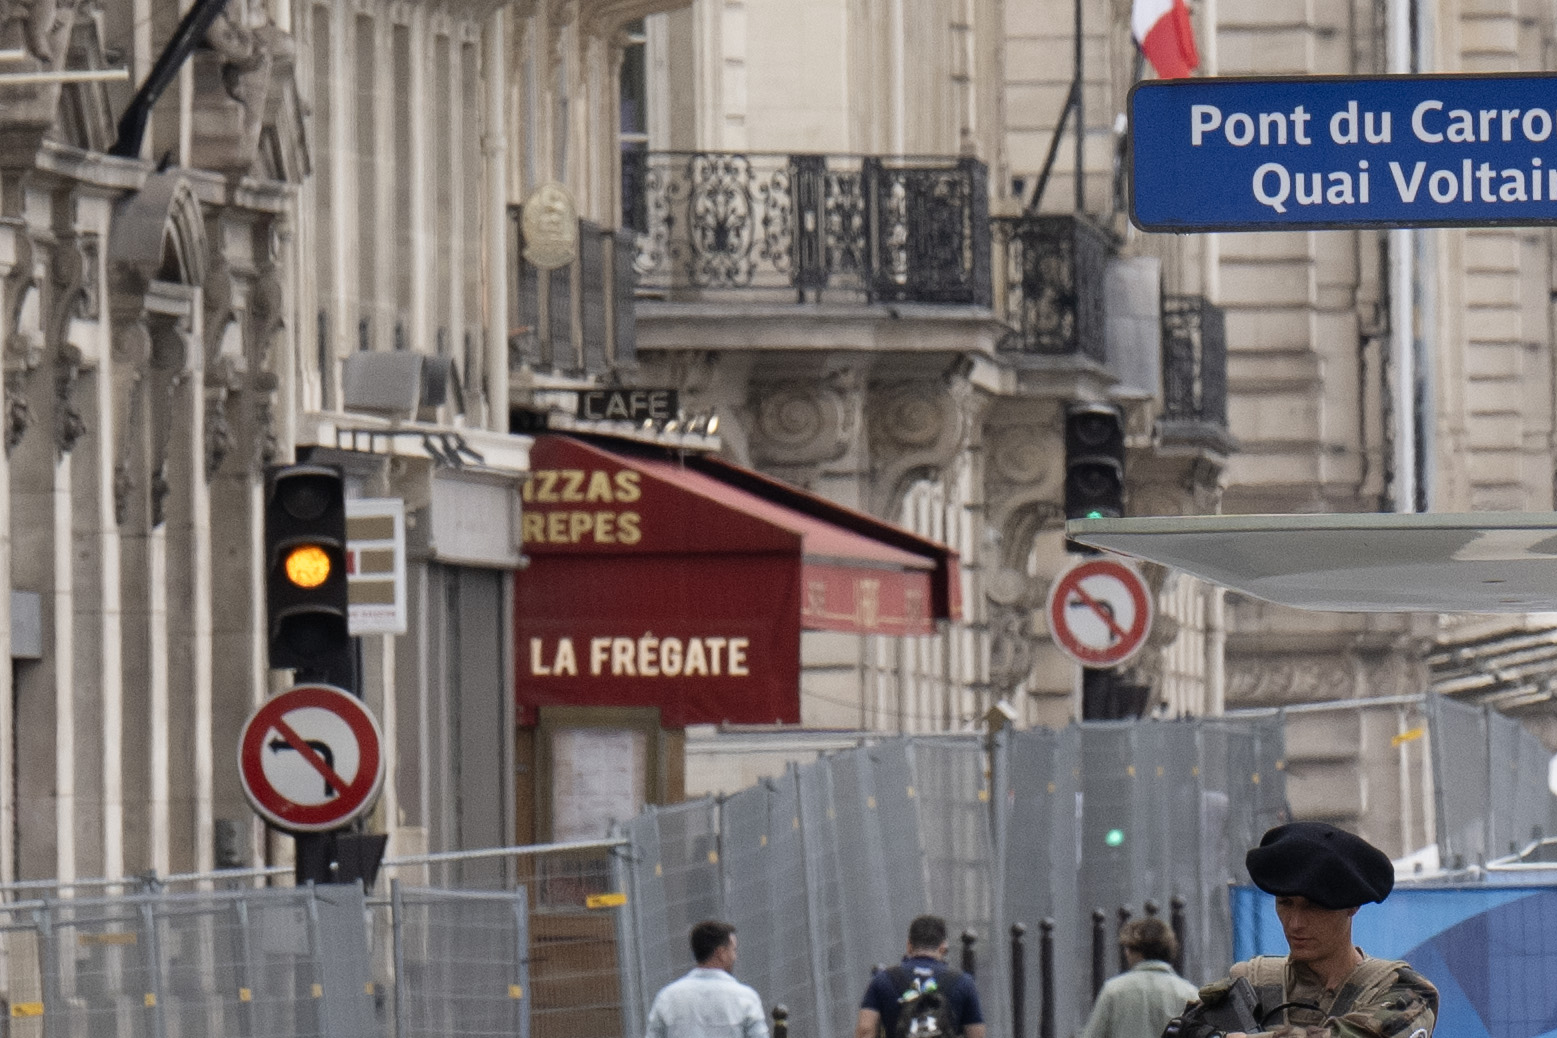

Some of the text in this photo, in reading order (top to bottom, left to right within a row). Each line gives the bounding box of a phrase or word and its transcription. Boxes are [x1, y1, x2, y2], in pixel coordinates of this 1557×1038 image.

[1191, 104, 1312, 146] Pont
[1329, 100, 1392, 145] du
[1252, 159, 1370, 213] Quai
[583, 392, 670, 420] CAFE
[522, 470, 642, 503] IZZAS
[522, 511, 643, 545] REPES
[530, 630, 750, 677] LA FRÉGATE
